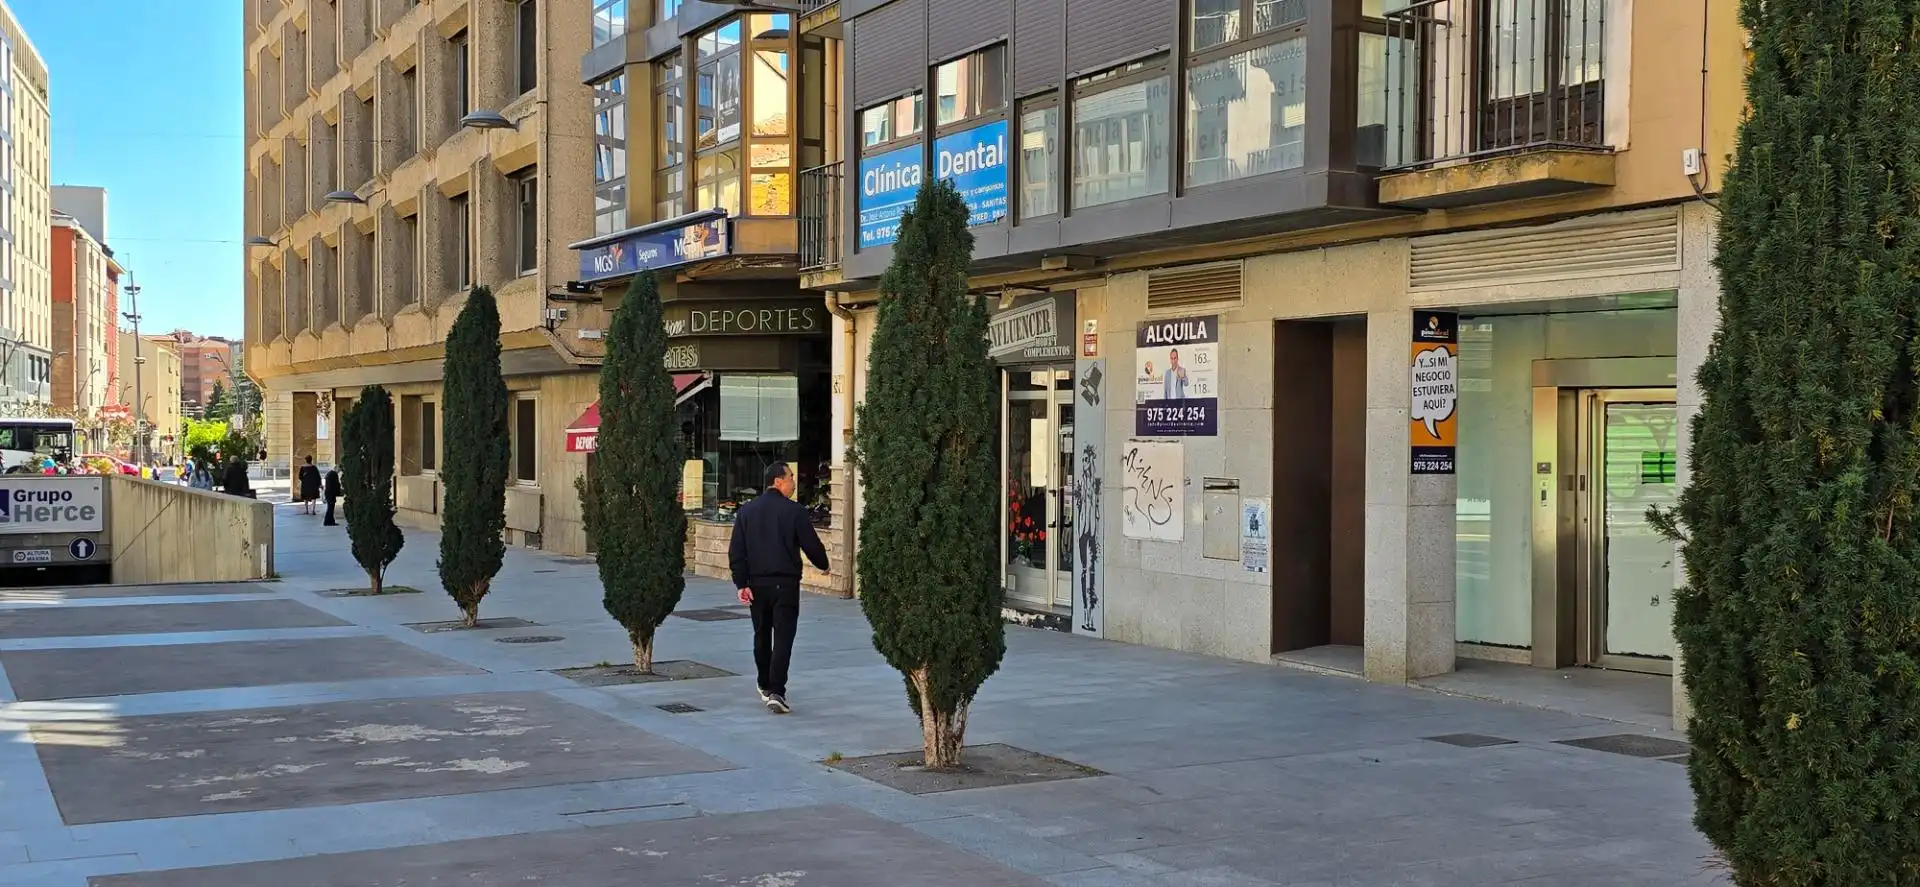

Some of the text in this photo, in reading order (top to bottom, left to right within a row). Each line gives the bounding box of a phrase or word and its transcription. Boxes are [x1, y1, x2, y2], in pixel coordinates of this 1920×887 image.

[864, 162, 921, 196] Clínica
[939, 135, 1003, 179] Dental
[876, 226, 890, 239] 975
[594, 254, 613, 273] MGS
[638, 248, 658, 263] Seguros
[691, 307, 815, 332] DEPORTES
[989, 308, 1051, 348] NFLUENCER
[1146, 321, 1208, 343] ALQUILA
[1024, 345, 1070, 357] COMPLEMENTOS
[1194, 353, 1207, 365] 163
[1438, 357, 1448, 367] MI
[1415, 370, 1451, 382] NEGOCIO
[1194, 383, 1207, 395] 118
[1413, 383, 1454, 397] ESTUVIERA
[1423, 398, 1446, 411] AQUÍ?
[1147, 406, 1205, 421] 975 224 254
[1413, 460, 1452, 471] 975 224 254
[13, 489, 72, 505] Grupo
[14, 504, 96, 523] Herce
